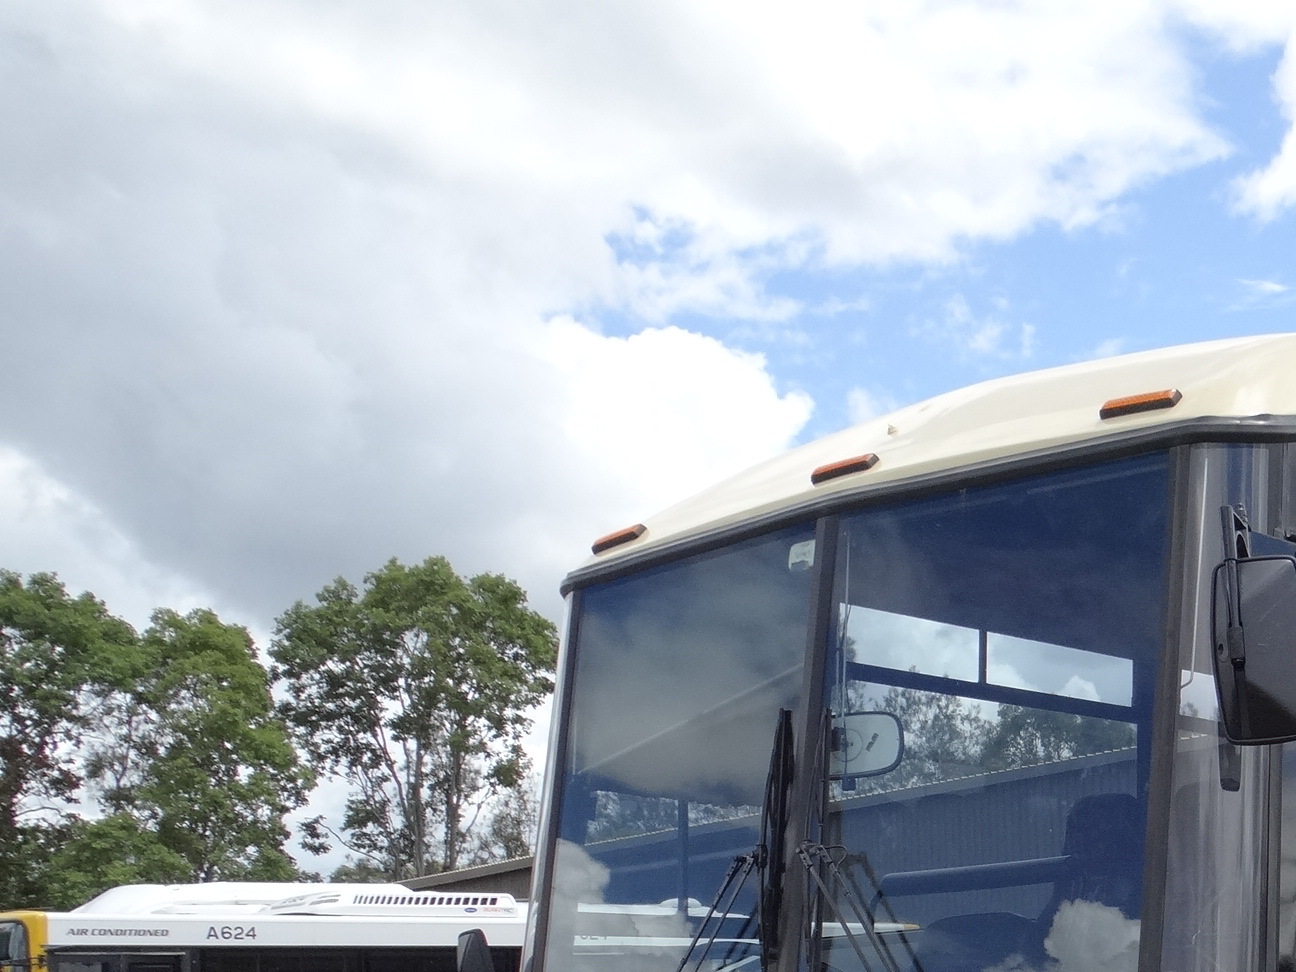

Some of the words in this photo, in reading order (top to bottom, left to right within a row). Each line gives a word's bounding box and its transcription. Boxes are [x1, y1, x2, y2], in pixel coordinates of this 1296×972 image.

[66, 928, 89, 937] AIR
[91, 928, 169, 938] CONDITIONED
[206, 926, 257, 940] A624
